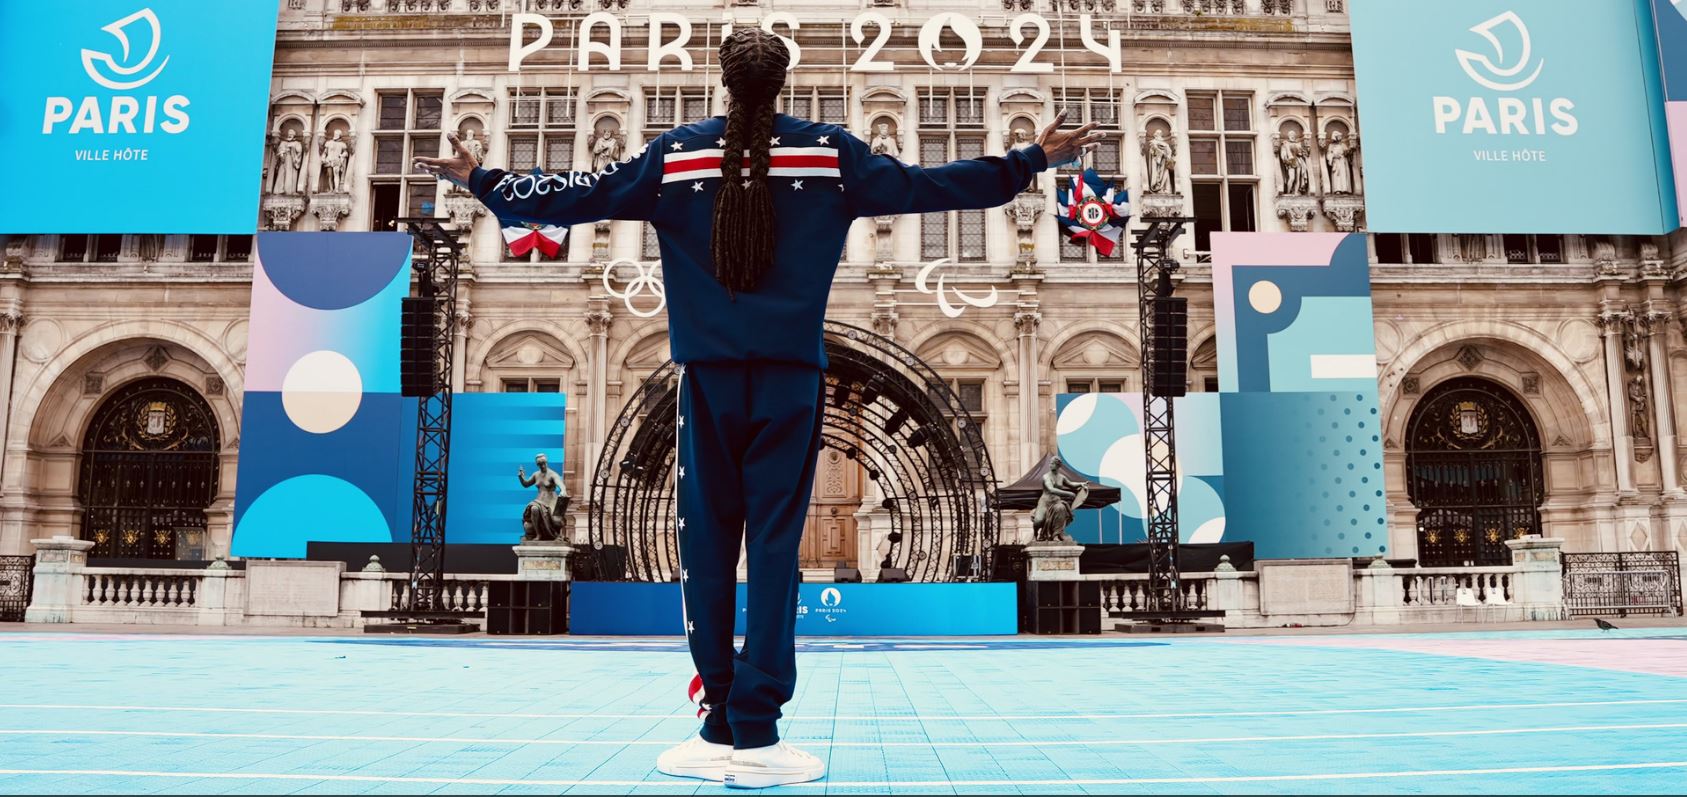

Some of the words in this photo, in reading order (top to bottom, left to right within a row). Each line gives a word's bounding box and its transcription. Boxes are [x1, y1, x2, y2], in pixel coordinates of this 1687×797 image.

[850, 12, 1122, 73] 2024
[42, 94, 191, 134] PARIS
[1432, 96, 1579, 136] PARIS
[75, 150, 109, 160] VILLE
[113, 147, 148, 160] HÔTE
[1473, 150, 1508, 161] VILLE
[1512, 148, 1546, 161] HÔTE
